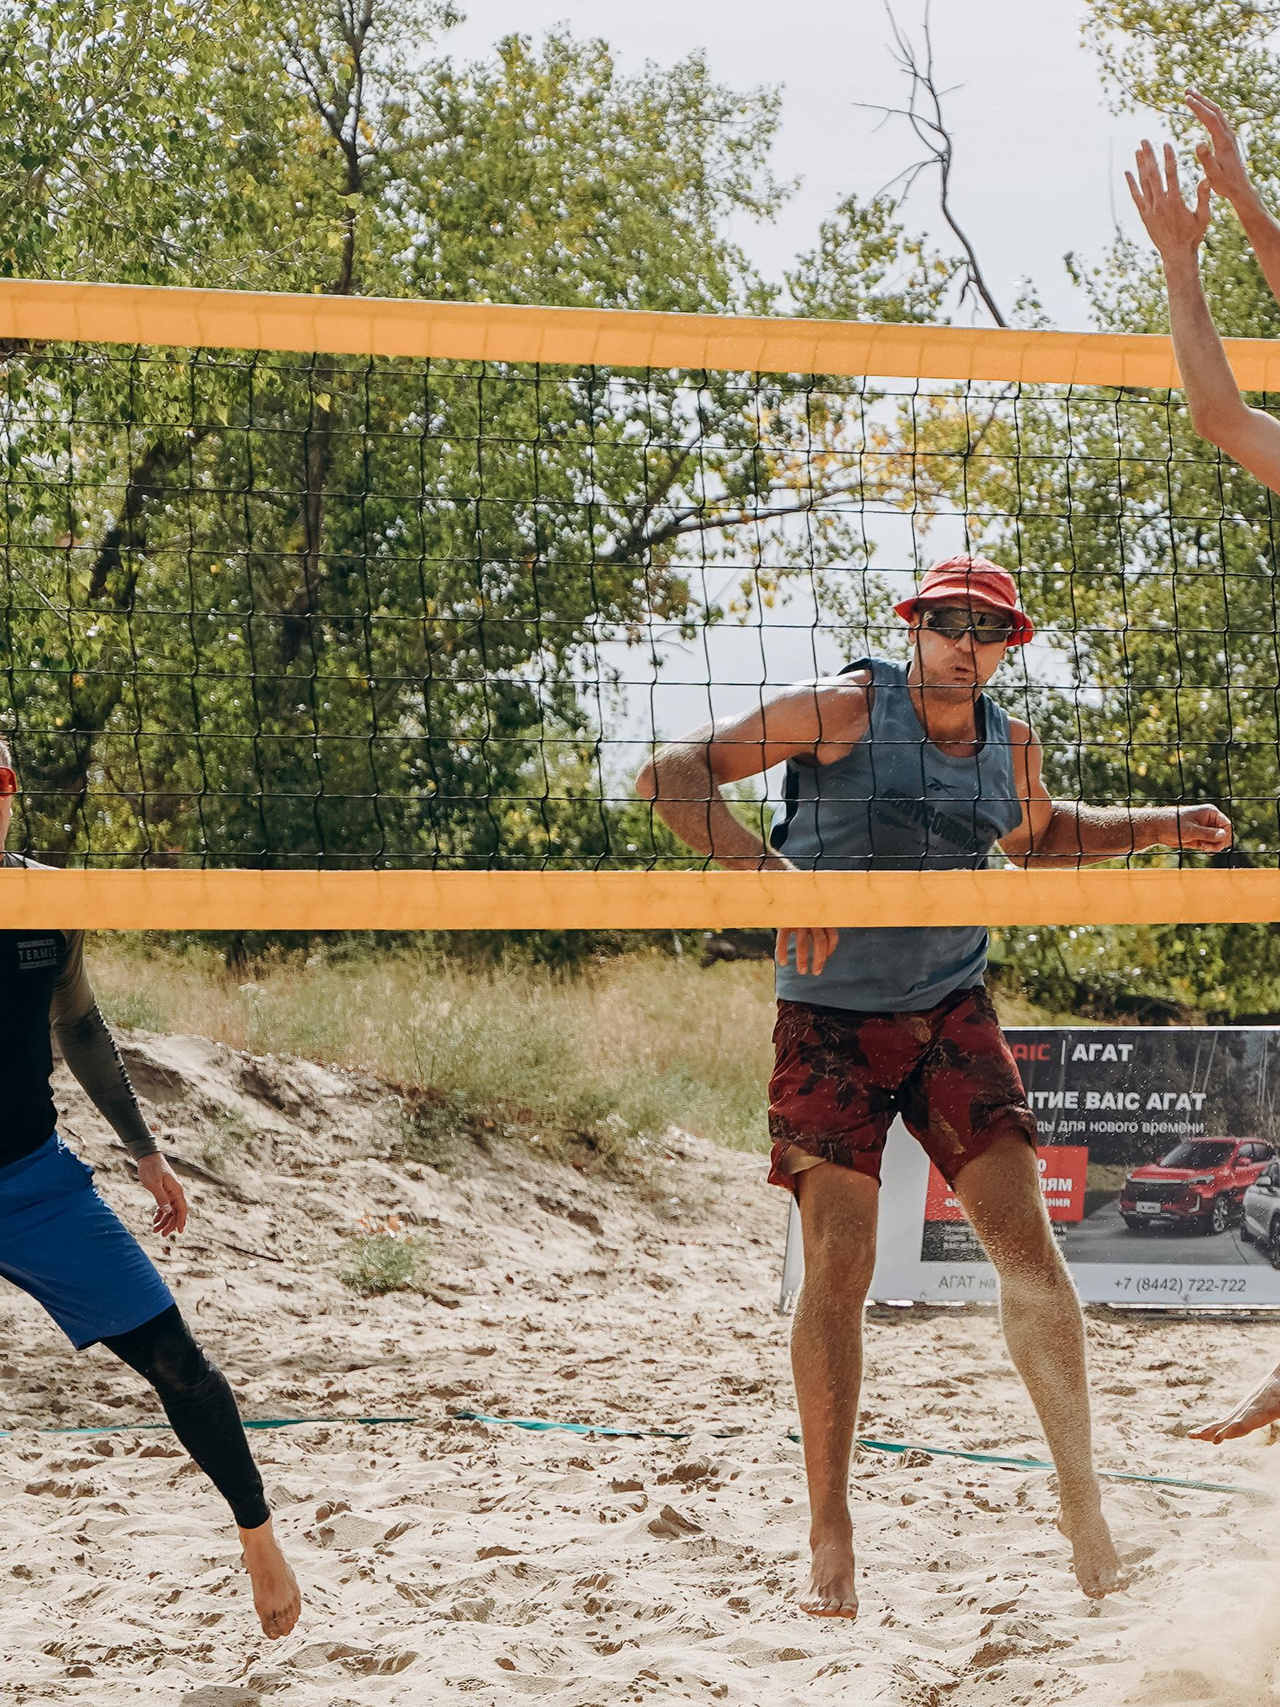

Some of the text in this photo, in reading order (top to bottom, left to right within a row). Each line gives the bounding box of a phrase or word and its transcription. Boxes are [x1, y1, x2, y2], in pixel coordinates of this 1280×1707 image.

[1012, 1043, 1051, 1061] AIC
[1071, 1043, 1134, 1062] АГАТ
[1146, 1092, 1207, 1111] АГАТ
[1058, 1120, 1086, 1134] для
[1089, 1120, 1139, 1134] нового
[1142, 1121, 1205, 1136] времени
[938, 1275, 976, 1290] АГАТ
[1114, 1277, 1247, 1294] +7 (8442) 722-722
